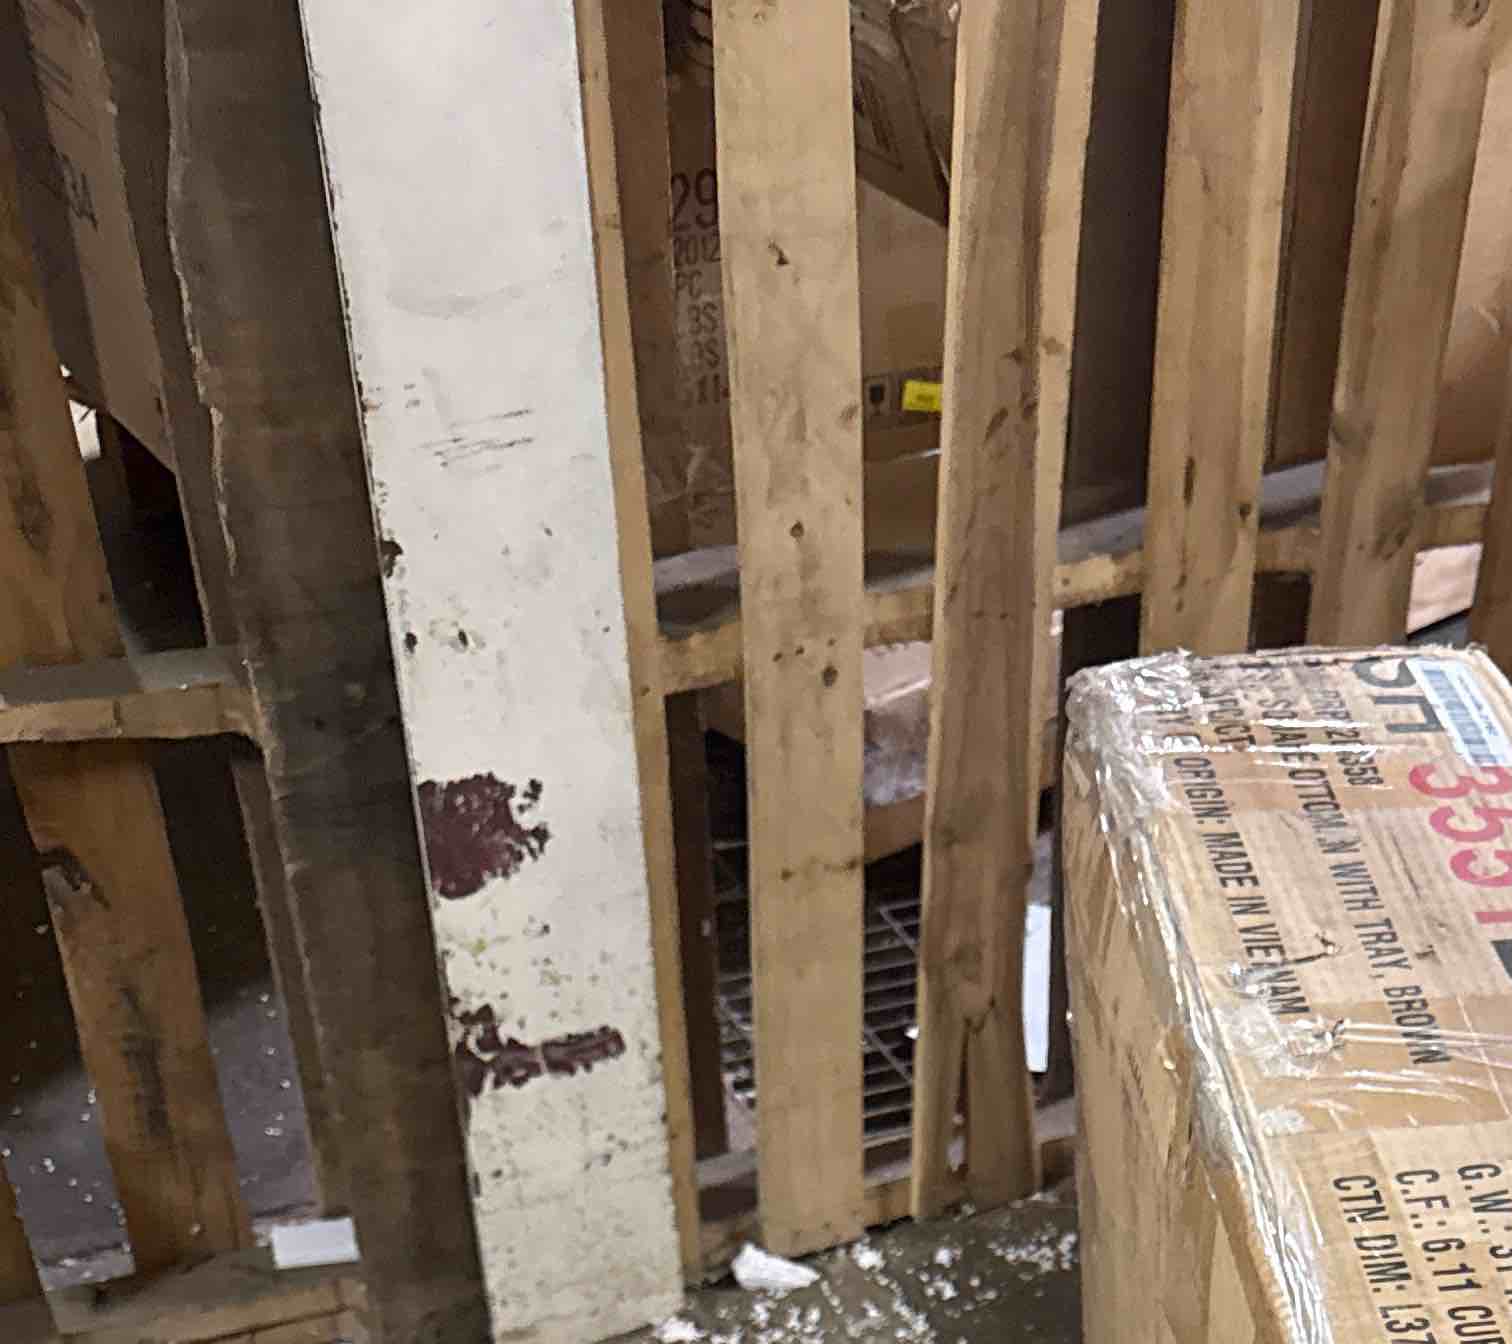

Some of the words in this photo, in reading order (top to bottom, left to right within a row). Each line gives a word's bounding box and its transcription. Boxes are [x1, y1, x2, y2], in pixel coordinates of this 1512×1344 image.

[1286, 766, 1360, 856] OTTOMN
[1201, 831, 1261, 889] MADE
[1329, 860, 1385, 912] WITH
[1226, 896, 1271, 917] IN
[1237, 922, 1312, 1017] VIENAM
[1353, 916, 1413, 980] TRAY,
[1383, 983, 1453, 1067] BROWN
[1331, 1173, 1392, 1225] CTN
[1393, 1168, 1451, 1231] C.F.:
[1352, 1233, 1413, 1294] DIM:
[1420, 1236, 1484, 1294] 6.11
